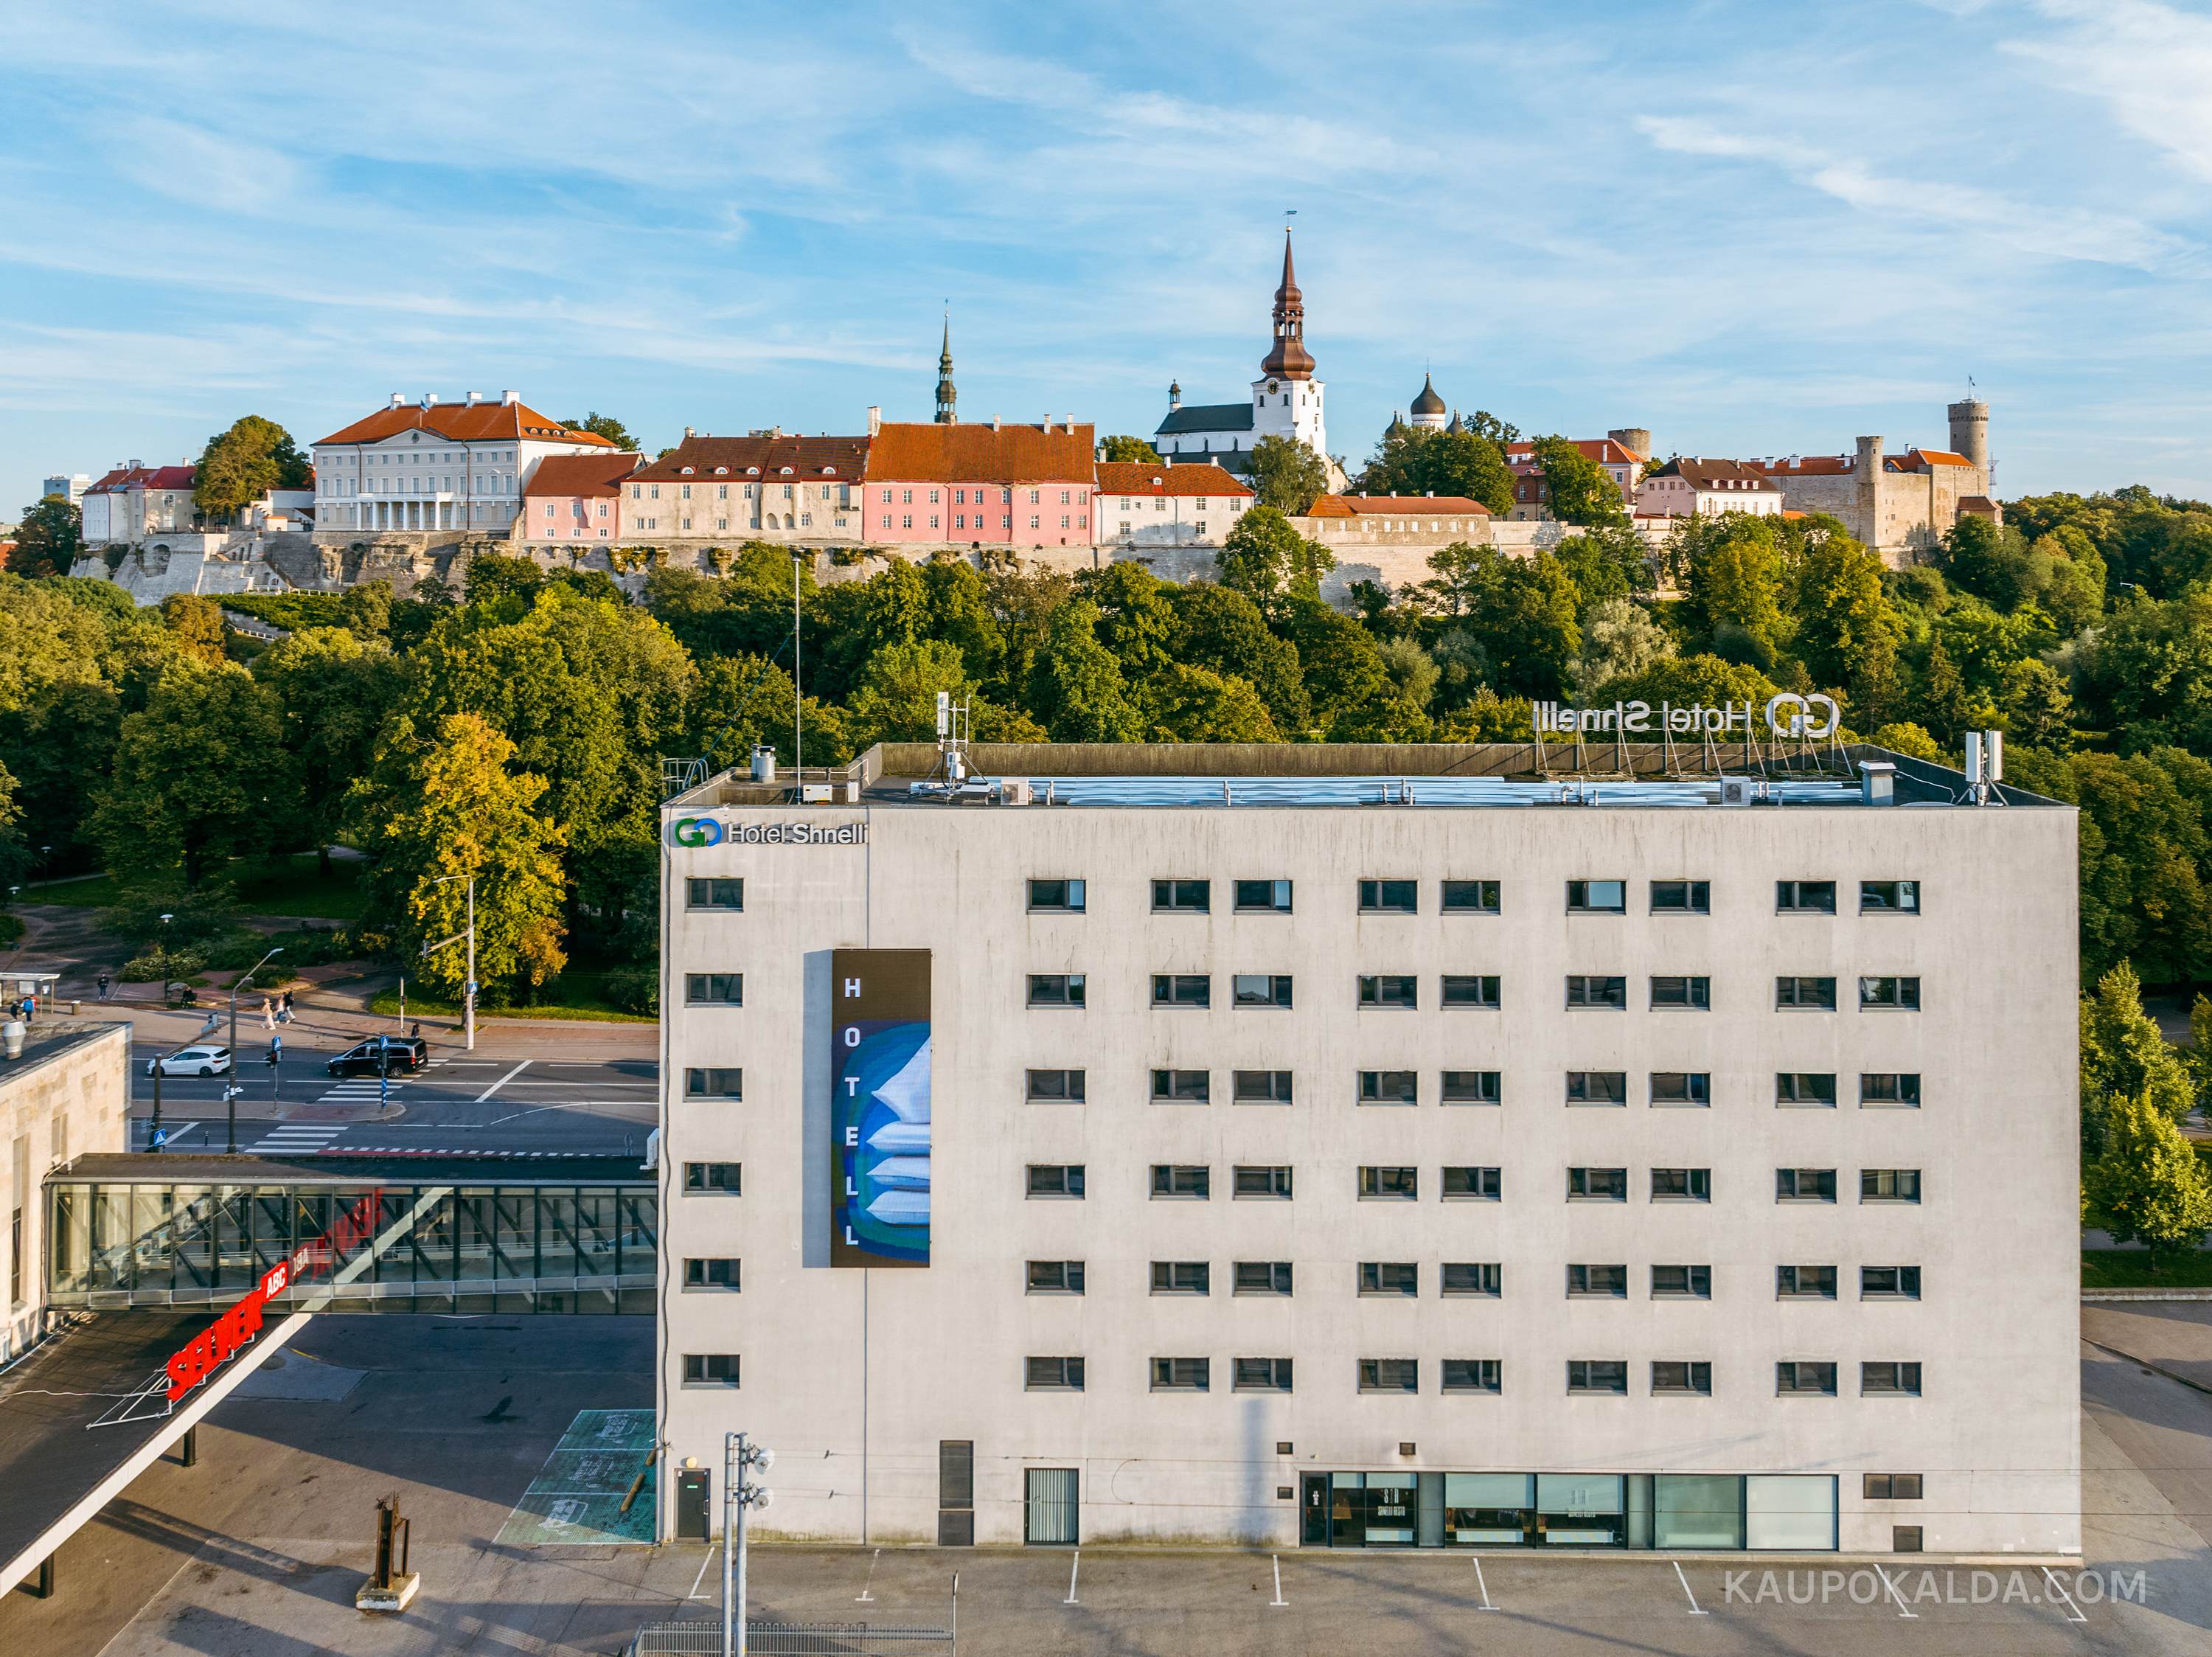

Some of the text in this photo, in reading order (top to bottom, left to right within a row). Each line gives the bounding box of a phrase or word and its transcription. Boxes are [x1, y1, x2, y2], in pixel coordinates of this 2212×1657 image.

[728, 822, 785, 844] Hotel
[792, 822, 869, 844] Shnelli
[844, 977, 861, 1246] HOTELL
[265, 1266, 286, 1299] ABC
